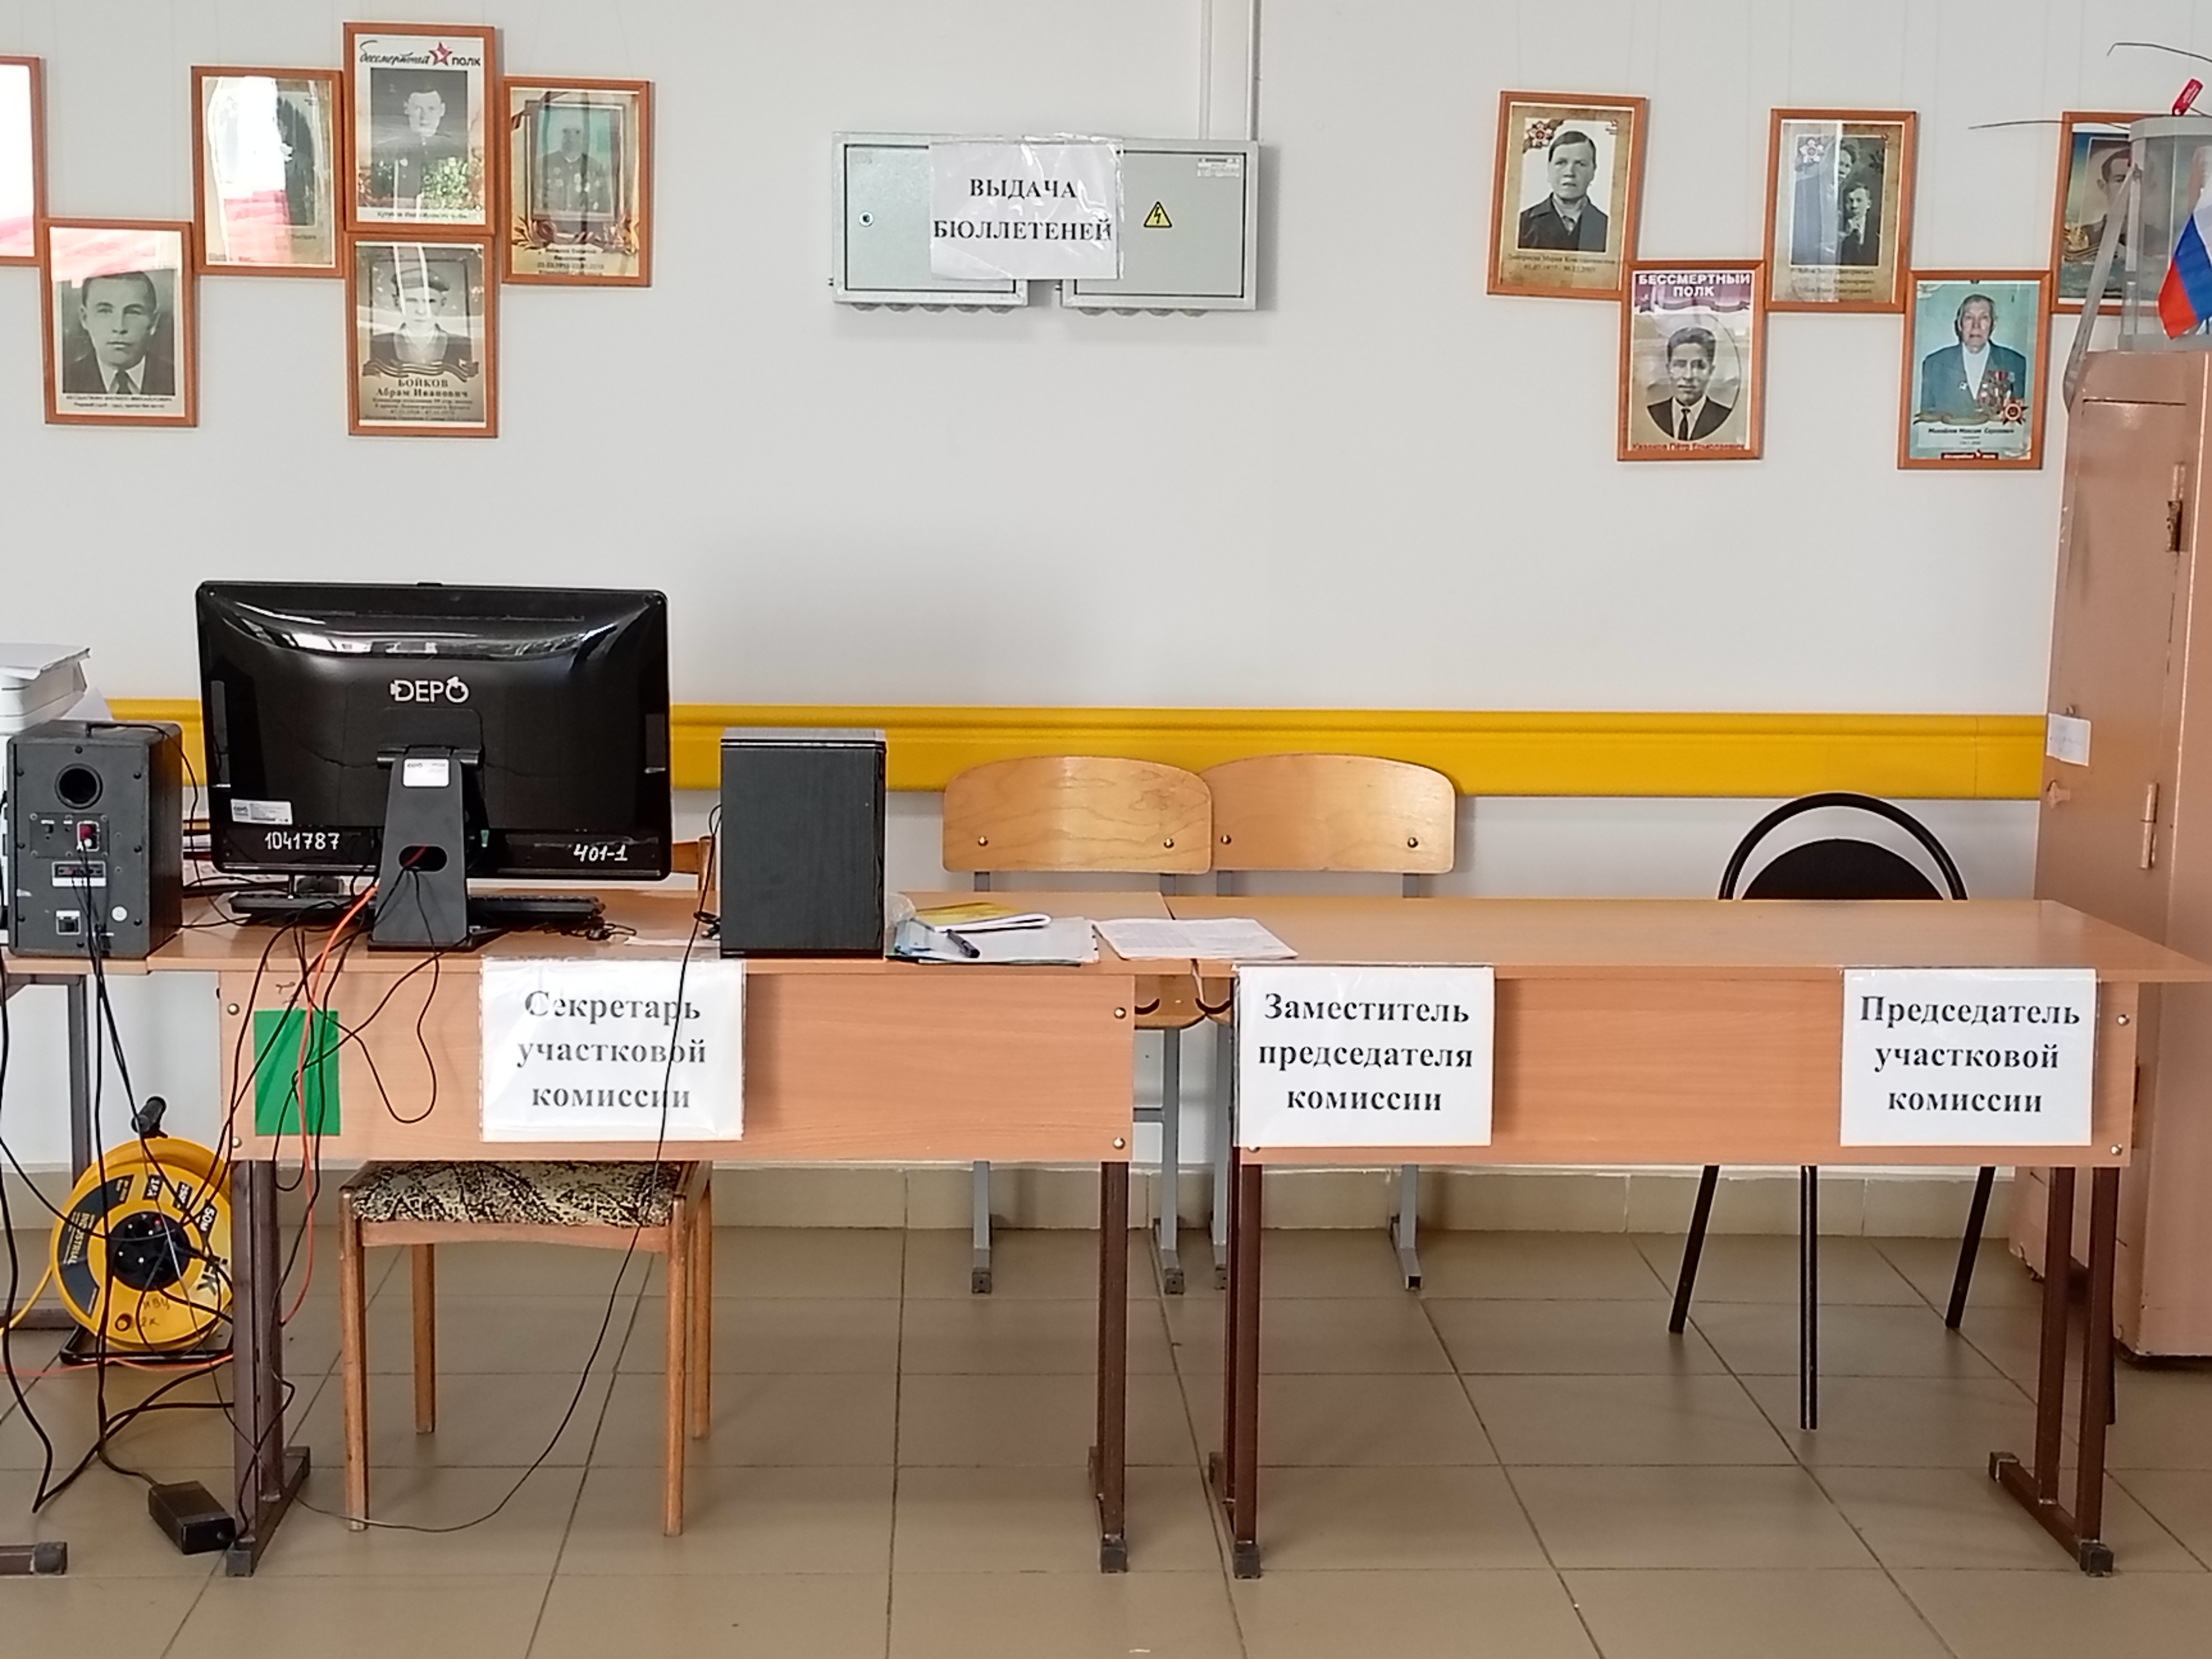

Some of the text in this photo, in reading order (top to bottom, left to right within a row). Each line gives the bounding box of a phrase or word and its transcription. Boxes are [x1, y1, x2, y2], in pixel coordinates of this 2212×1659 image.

[969, 179, 1077, 200] ВЫДАЧА
[933, 218, 1112, 240] БЮЛЛЕТЕНЕЙ
[1638, 274, 1751, 285] БЕССМЕРТНЫЙ
[1673, 286, 1715, 297] ПОЛК
[376, 388, 468, 397] Абрам Иванович
[398, 378, 449, 387] БОЙКОВ
[390, 676, 469, 703] DEPO
[264, 831, 340, 850] 1041787
[573, 843, 628, 862] 401-1
[524, 990, 701, 1026] Секретарь
[1264, 993, 1469, 1023] Заместитель
[1860, 996, 2080, 1029] Председатель
[517, 1038, 706, 1068] участковой
[1258, 1045, 1473, 1071] председателя
[1874, 1044, 2060, 1072] участковой
[532, 1087, 690, 1108] комиссии
[1287, 1090, 1442, 1111] комиссии
[1887, 1092, 2043, 1113] комиссии
